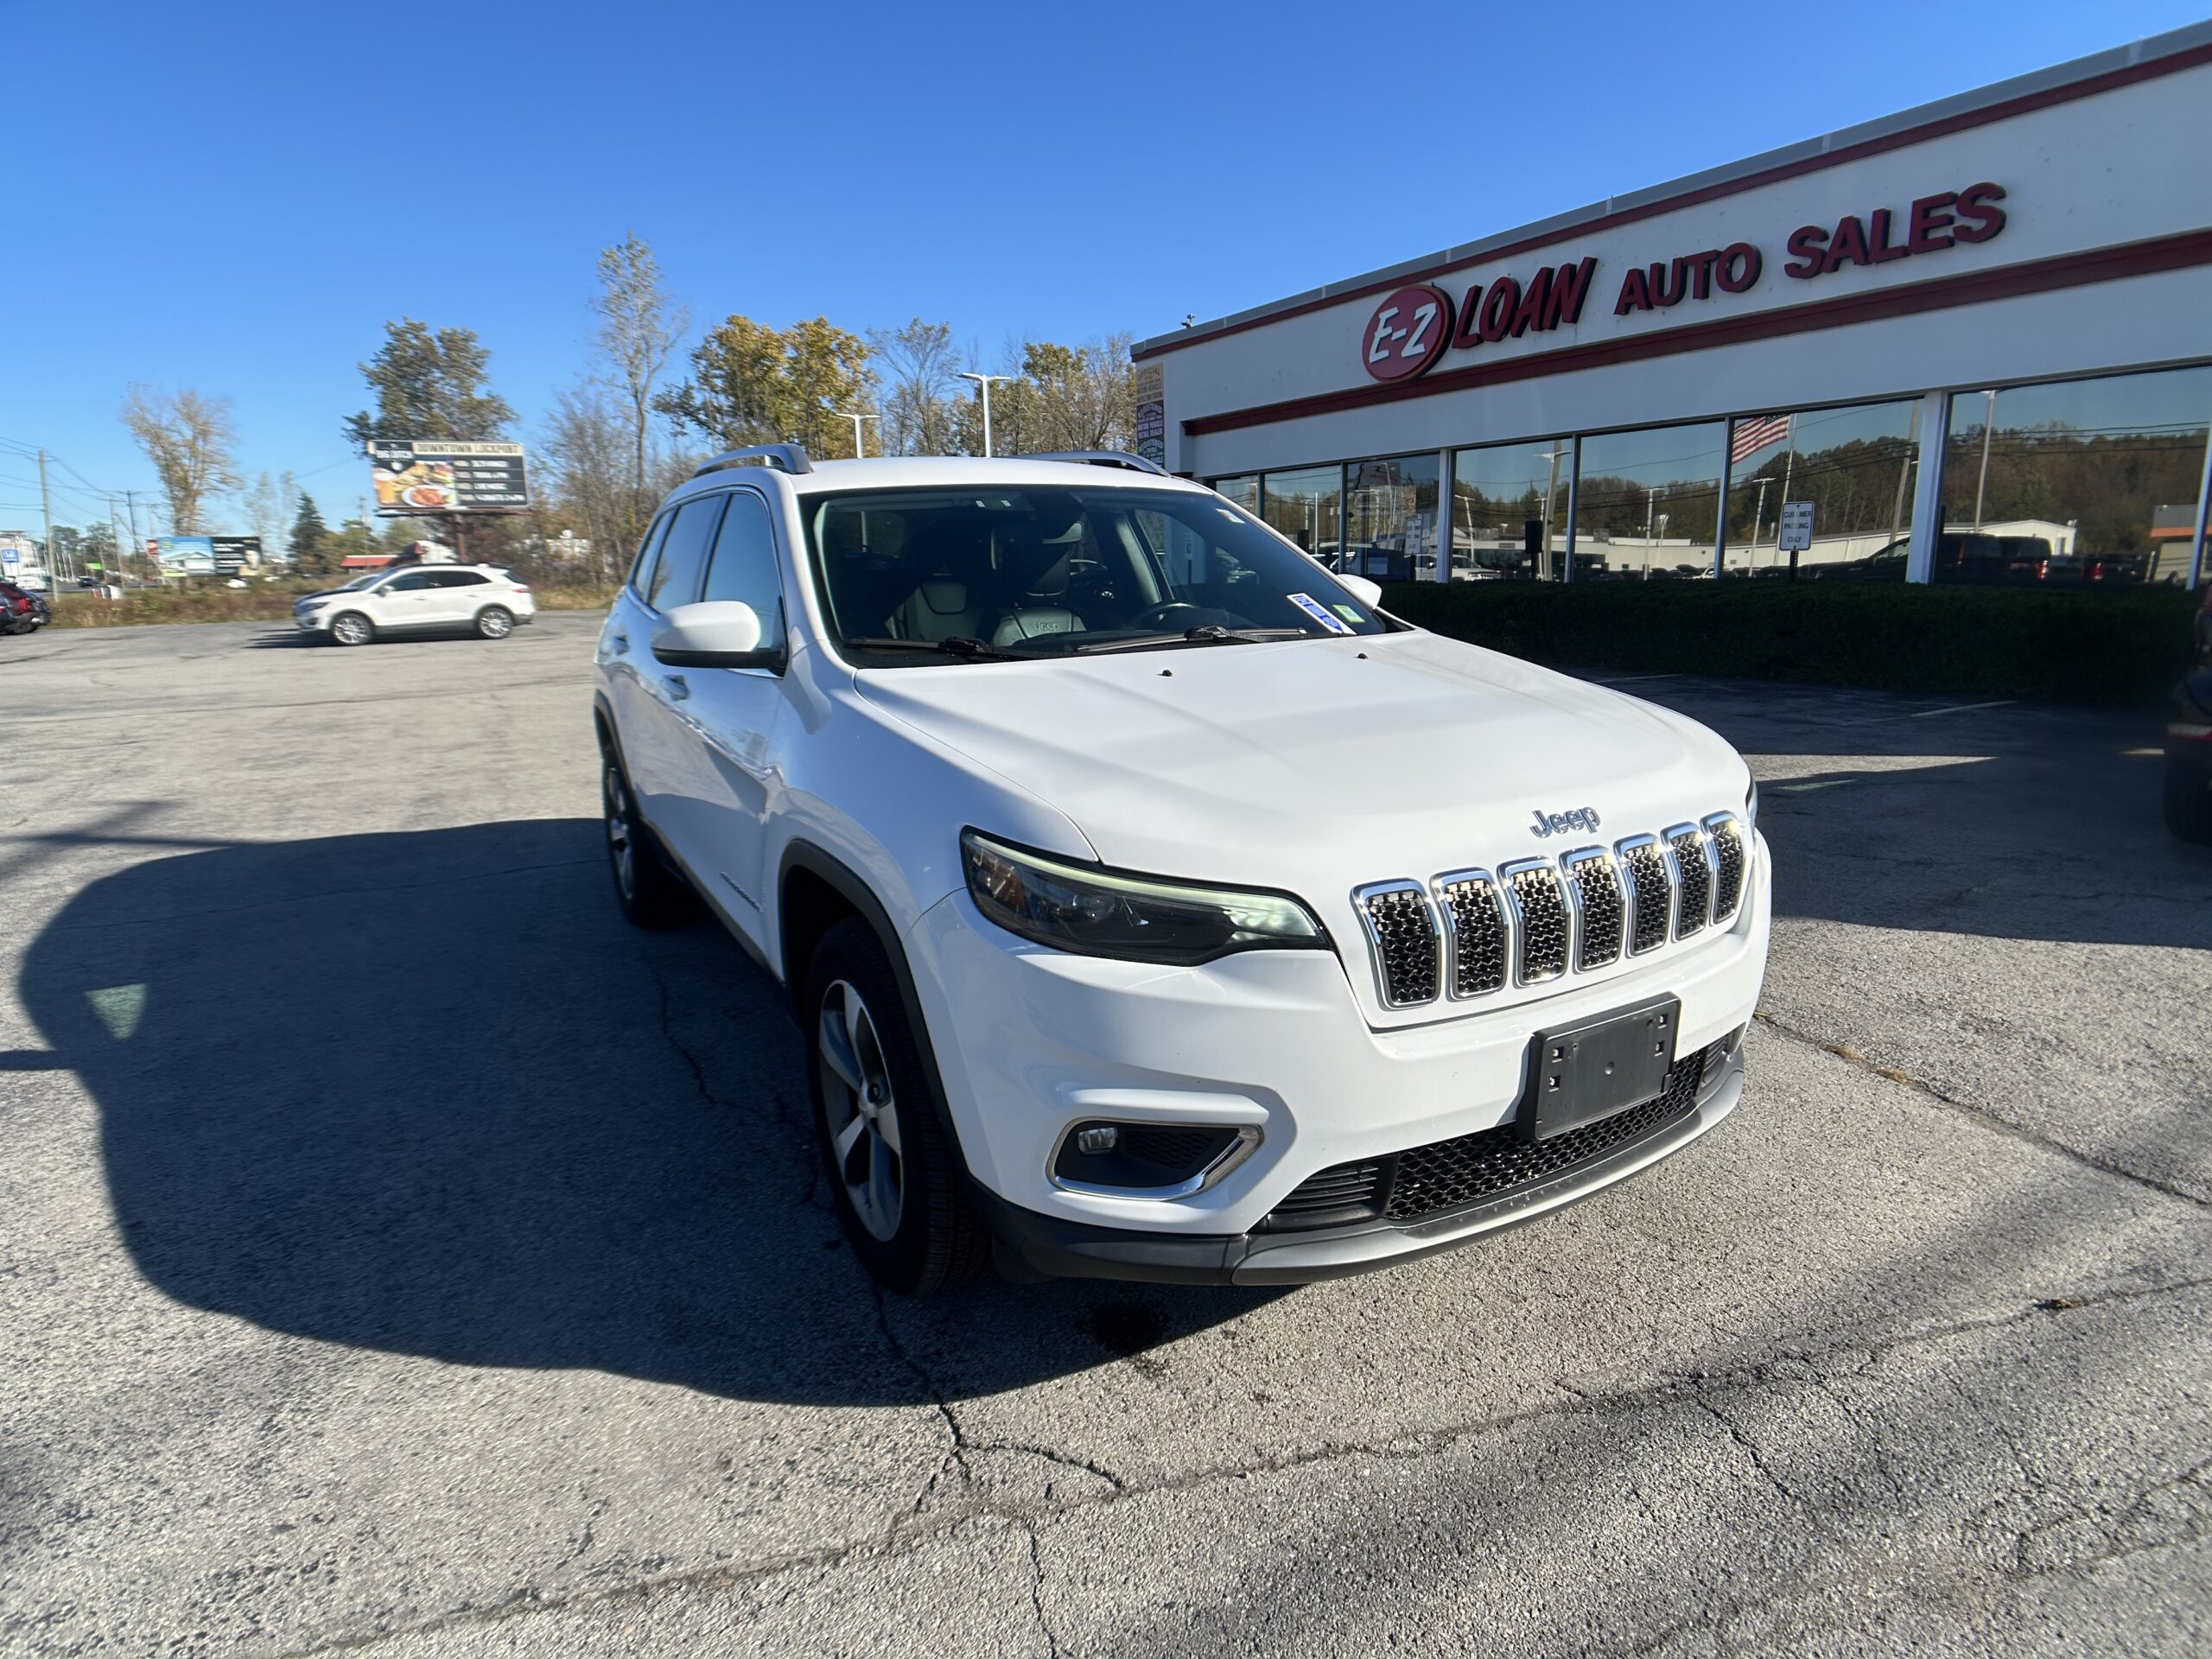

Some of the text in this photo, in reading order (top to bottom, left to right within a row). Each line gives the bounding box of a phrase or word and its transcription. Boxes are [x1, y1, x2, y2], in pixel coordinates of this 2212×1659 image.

[1368, 181, 2007, 365] E-Z LOAN AUTO SALES
[417, 443, 472, 453] DOWNTOWN
[1529, 806, 1601, 838] Jeep
